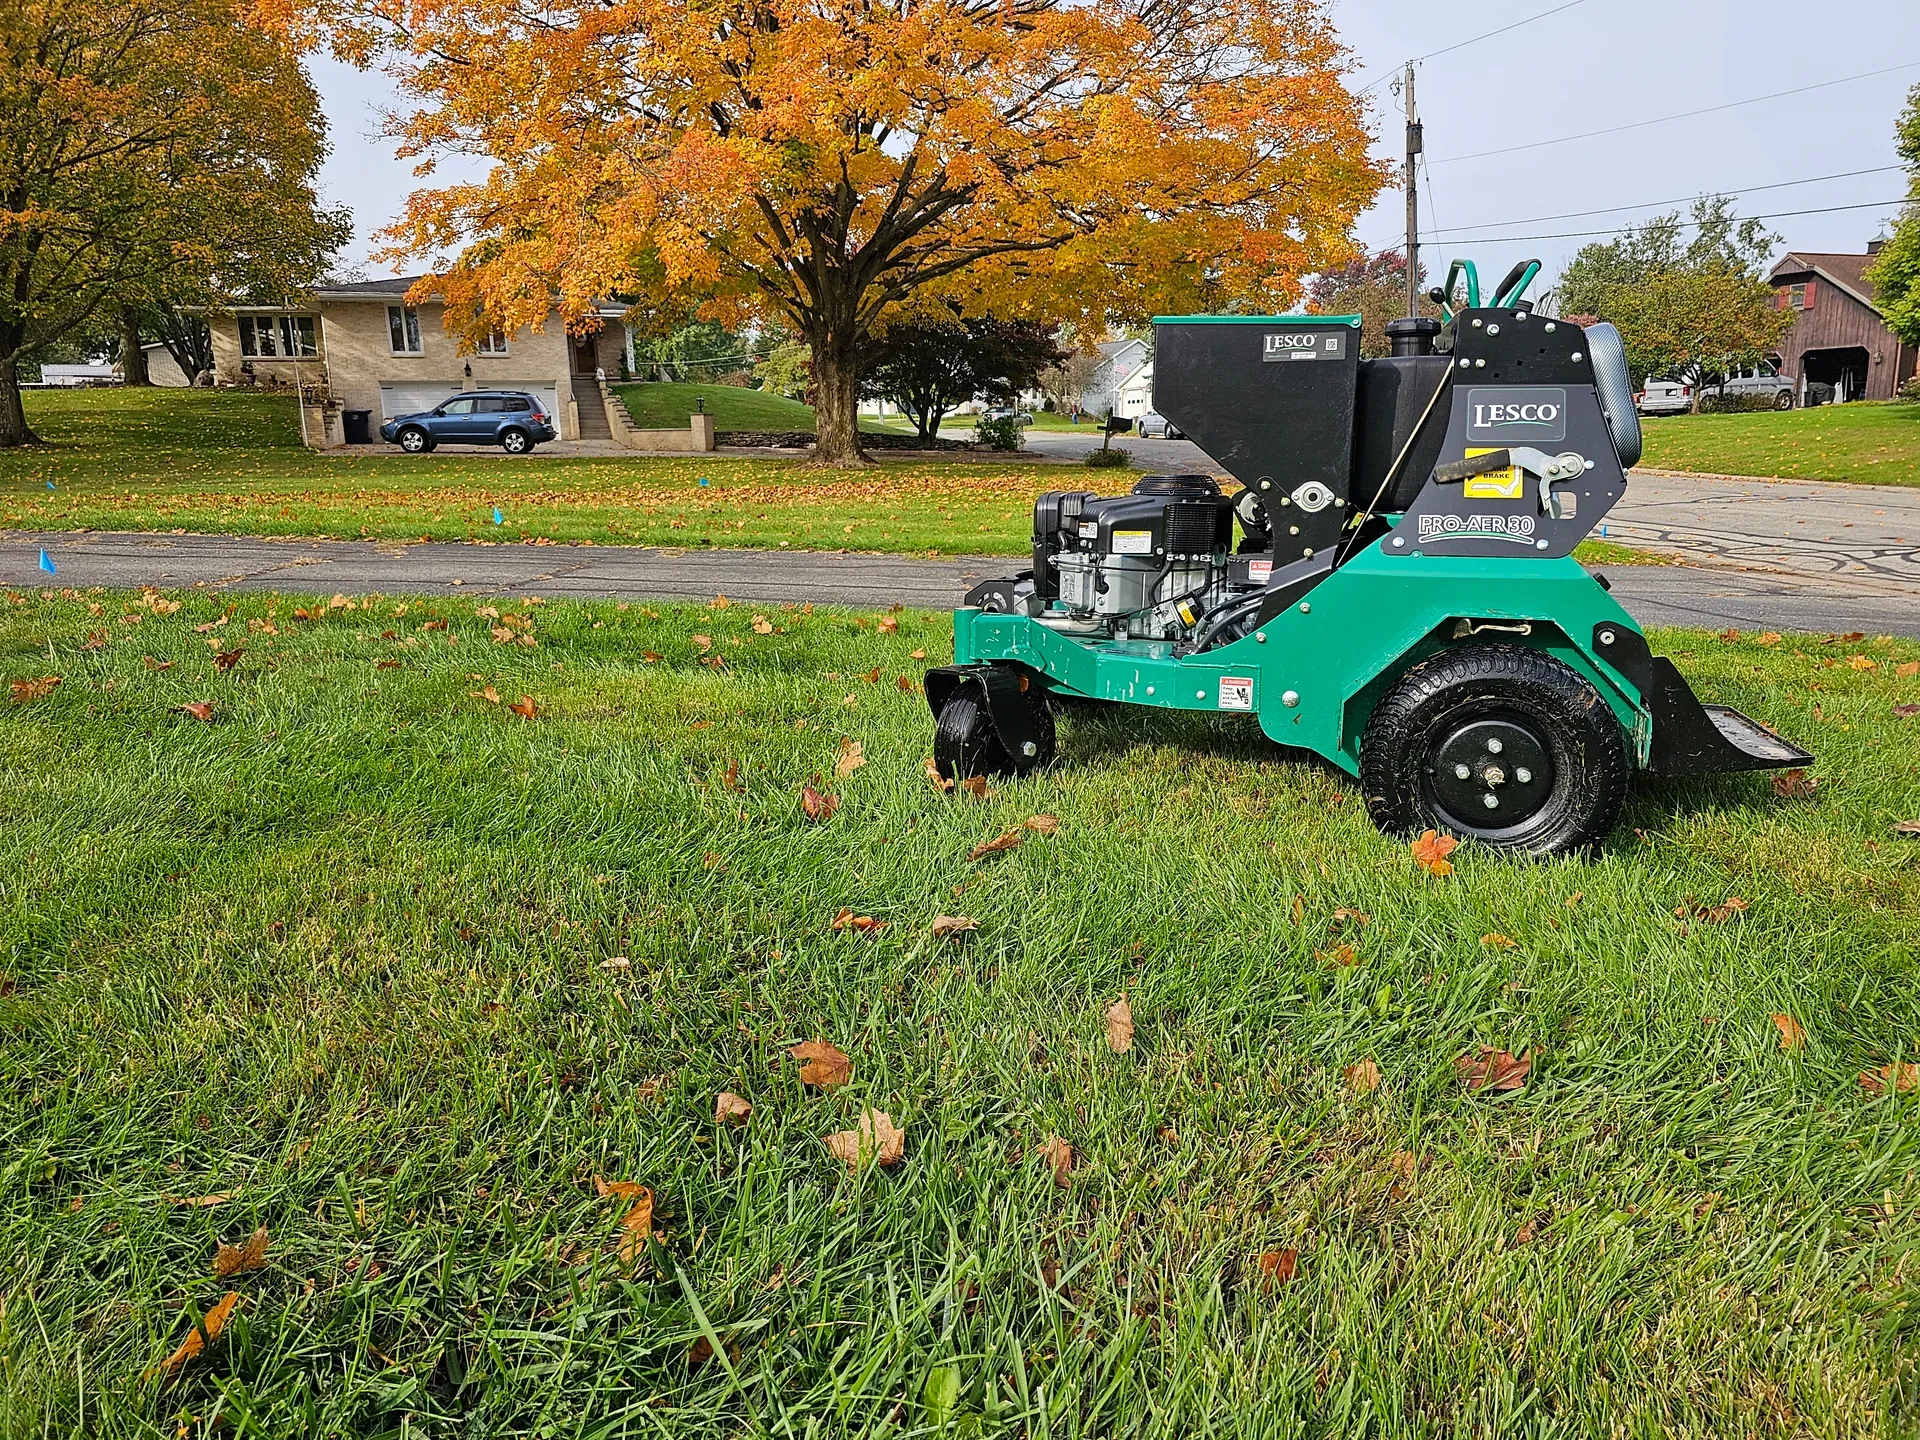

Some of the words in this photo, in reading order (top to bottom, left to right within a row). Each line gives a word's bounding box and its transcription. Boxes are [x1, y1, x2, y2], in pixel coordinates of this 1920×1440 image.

[1265, 334, 1315, 353] LESCO
[1473, 404, 1558, 428] LESCO
[1419, 515, 1507, 534] PRO-AER
[1509, 515, 1535, 535] 30
